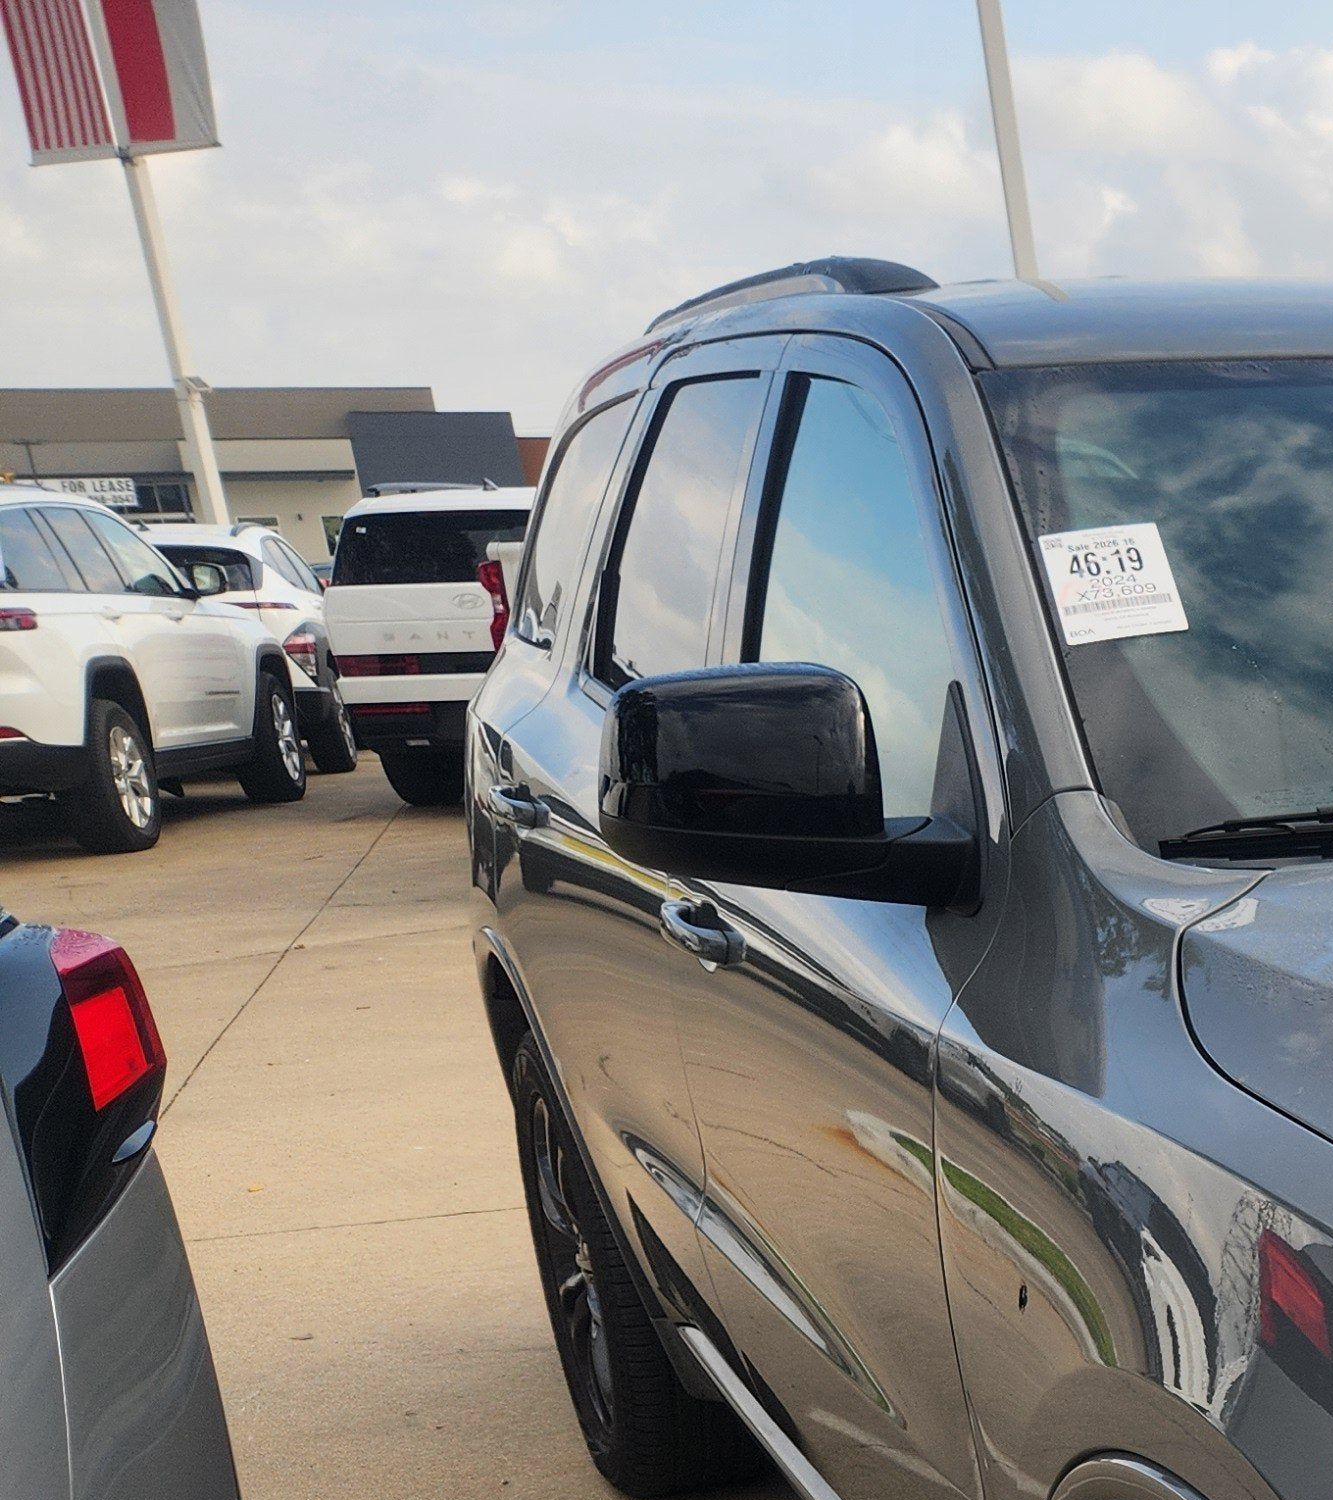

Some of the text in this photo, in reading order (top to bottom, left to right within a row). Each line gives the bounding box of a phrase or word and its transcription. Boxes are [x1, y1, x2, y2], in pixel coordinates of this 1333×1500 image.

[61, 480, 133, 493] FOR LEASE
[1067, 543, 1090, 552] Sale
[1069, 547, 1144, 578] 46:19
[1089, 574, 1137, 589] 2024
